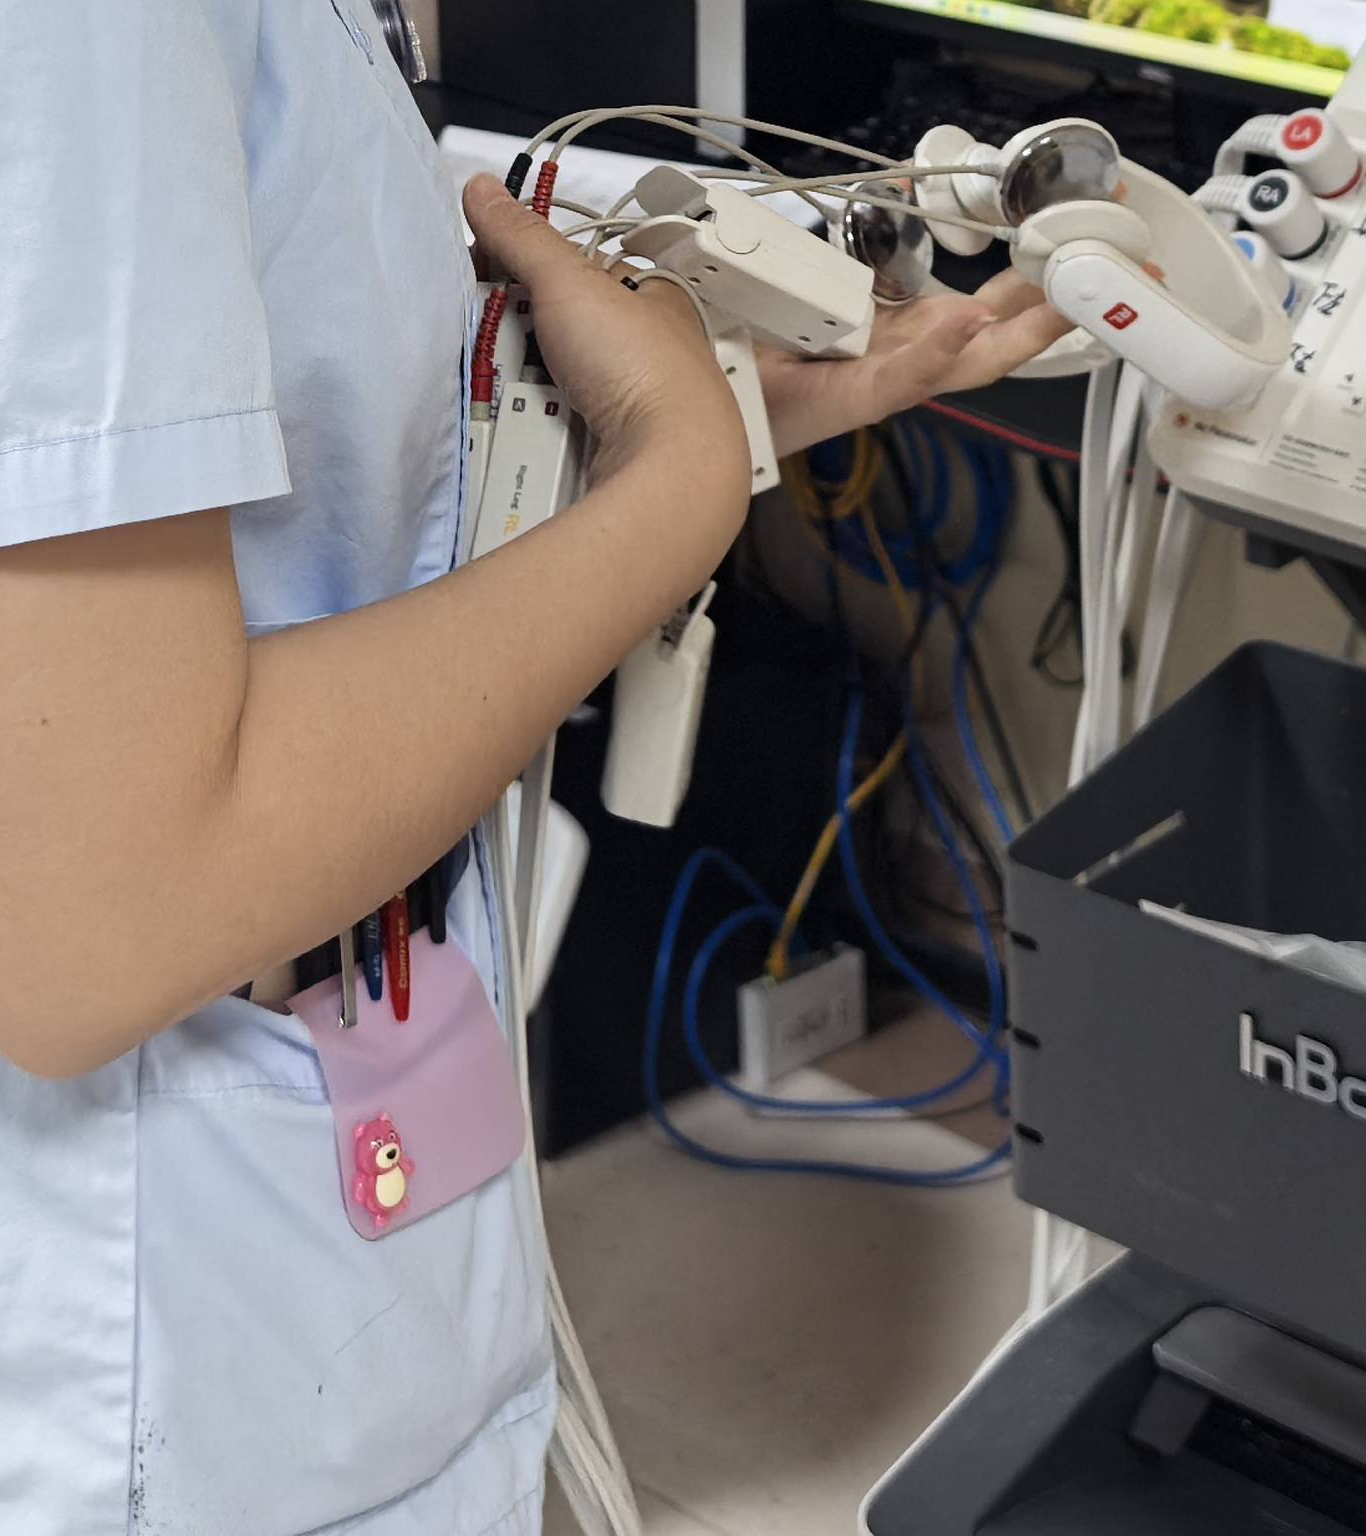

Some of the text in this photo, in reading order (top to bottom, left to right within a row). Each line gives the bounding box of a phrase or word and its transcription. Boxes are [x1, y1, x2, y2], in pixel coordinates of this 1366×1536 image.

[1291, 126, 1314, 142] LA
[1256, 185, 1280, 204] RA
[1108, 307, 1132, 324] RL
